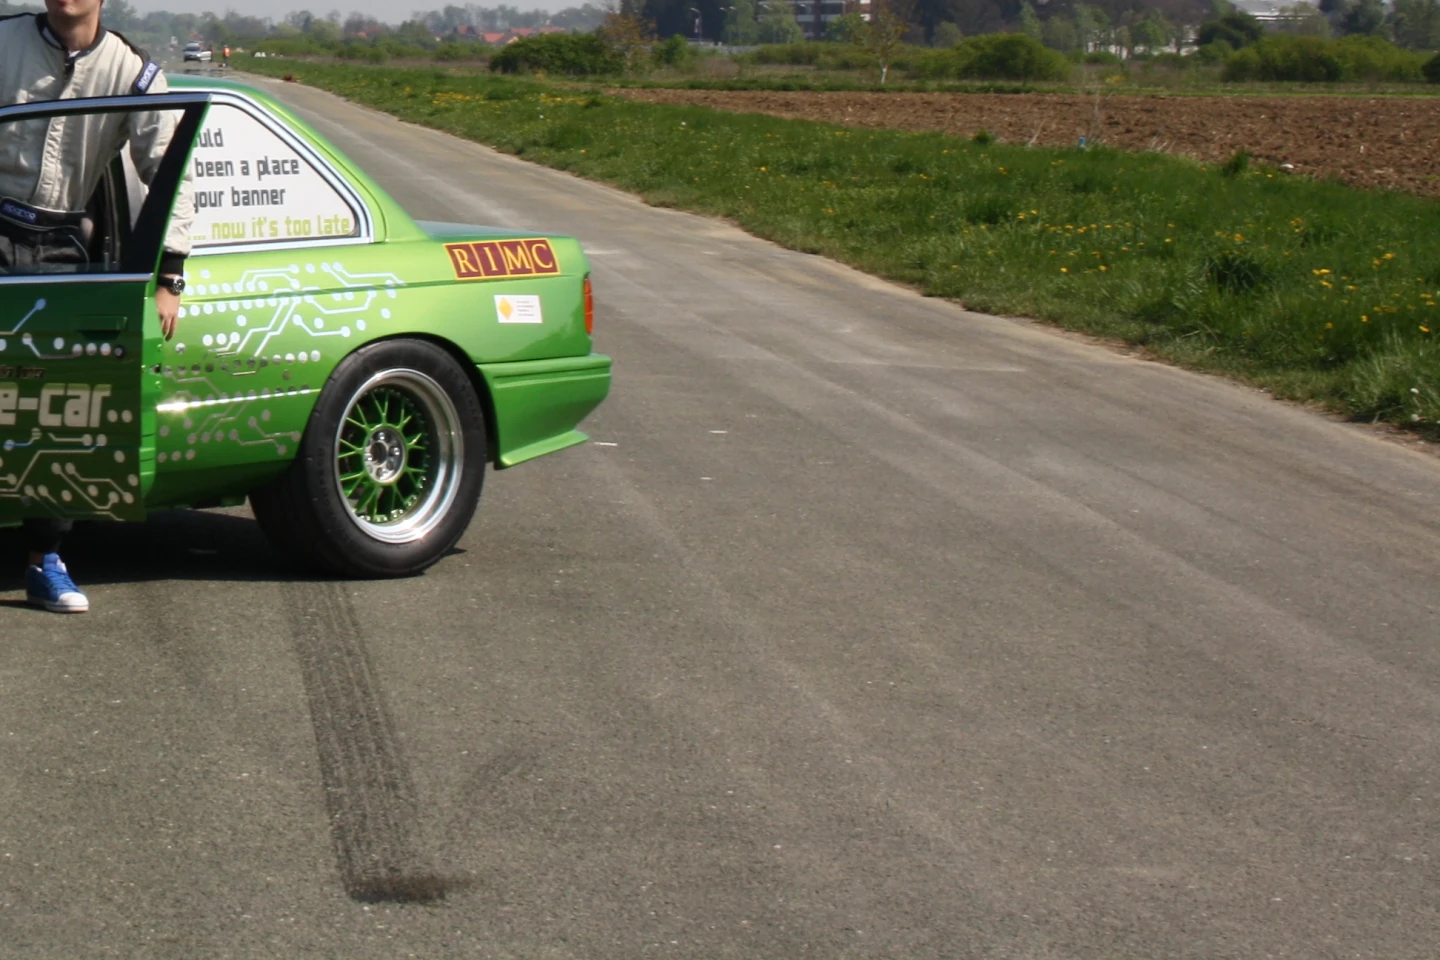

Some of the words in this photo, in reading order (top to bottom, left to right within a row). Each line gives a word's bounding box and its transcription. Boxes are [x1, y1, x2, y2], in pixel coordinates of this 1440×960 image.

[194, 157, 234, 177] been
[240, 160, 250, 176] a
[257, 156, 300, 181] place
[193, 191, 225, 214] your
[230, 186, 285, 207] banner
[211, 222, 246, 240] now
[251, 216, 278, 238] it's
[285, 214, 311, 236] too
[317, 214, 351, 235] late
